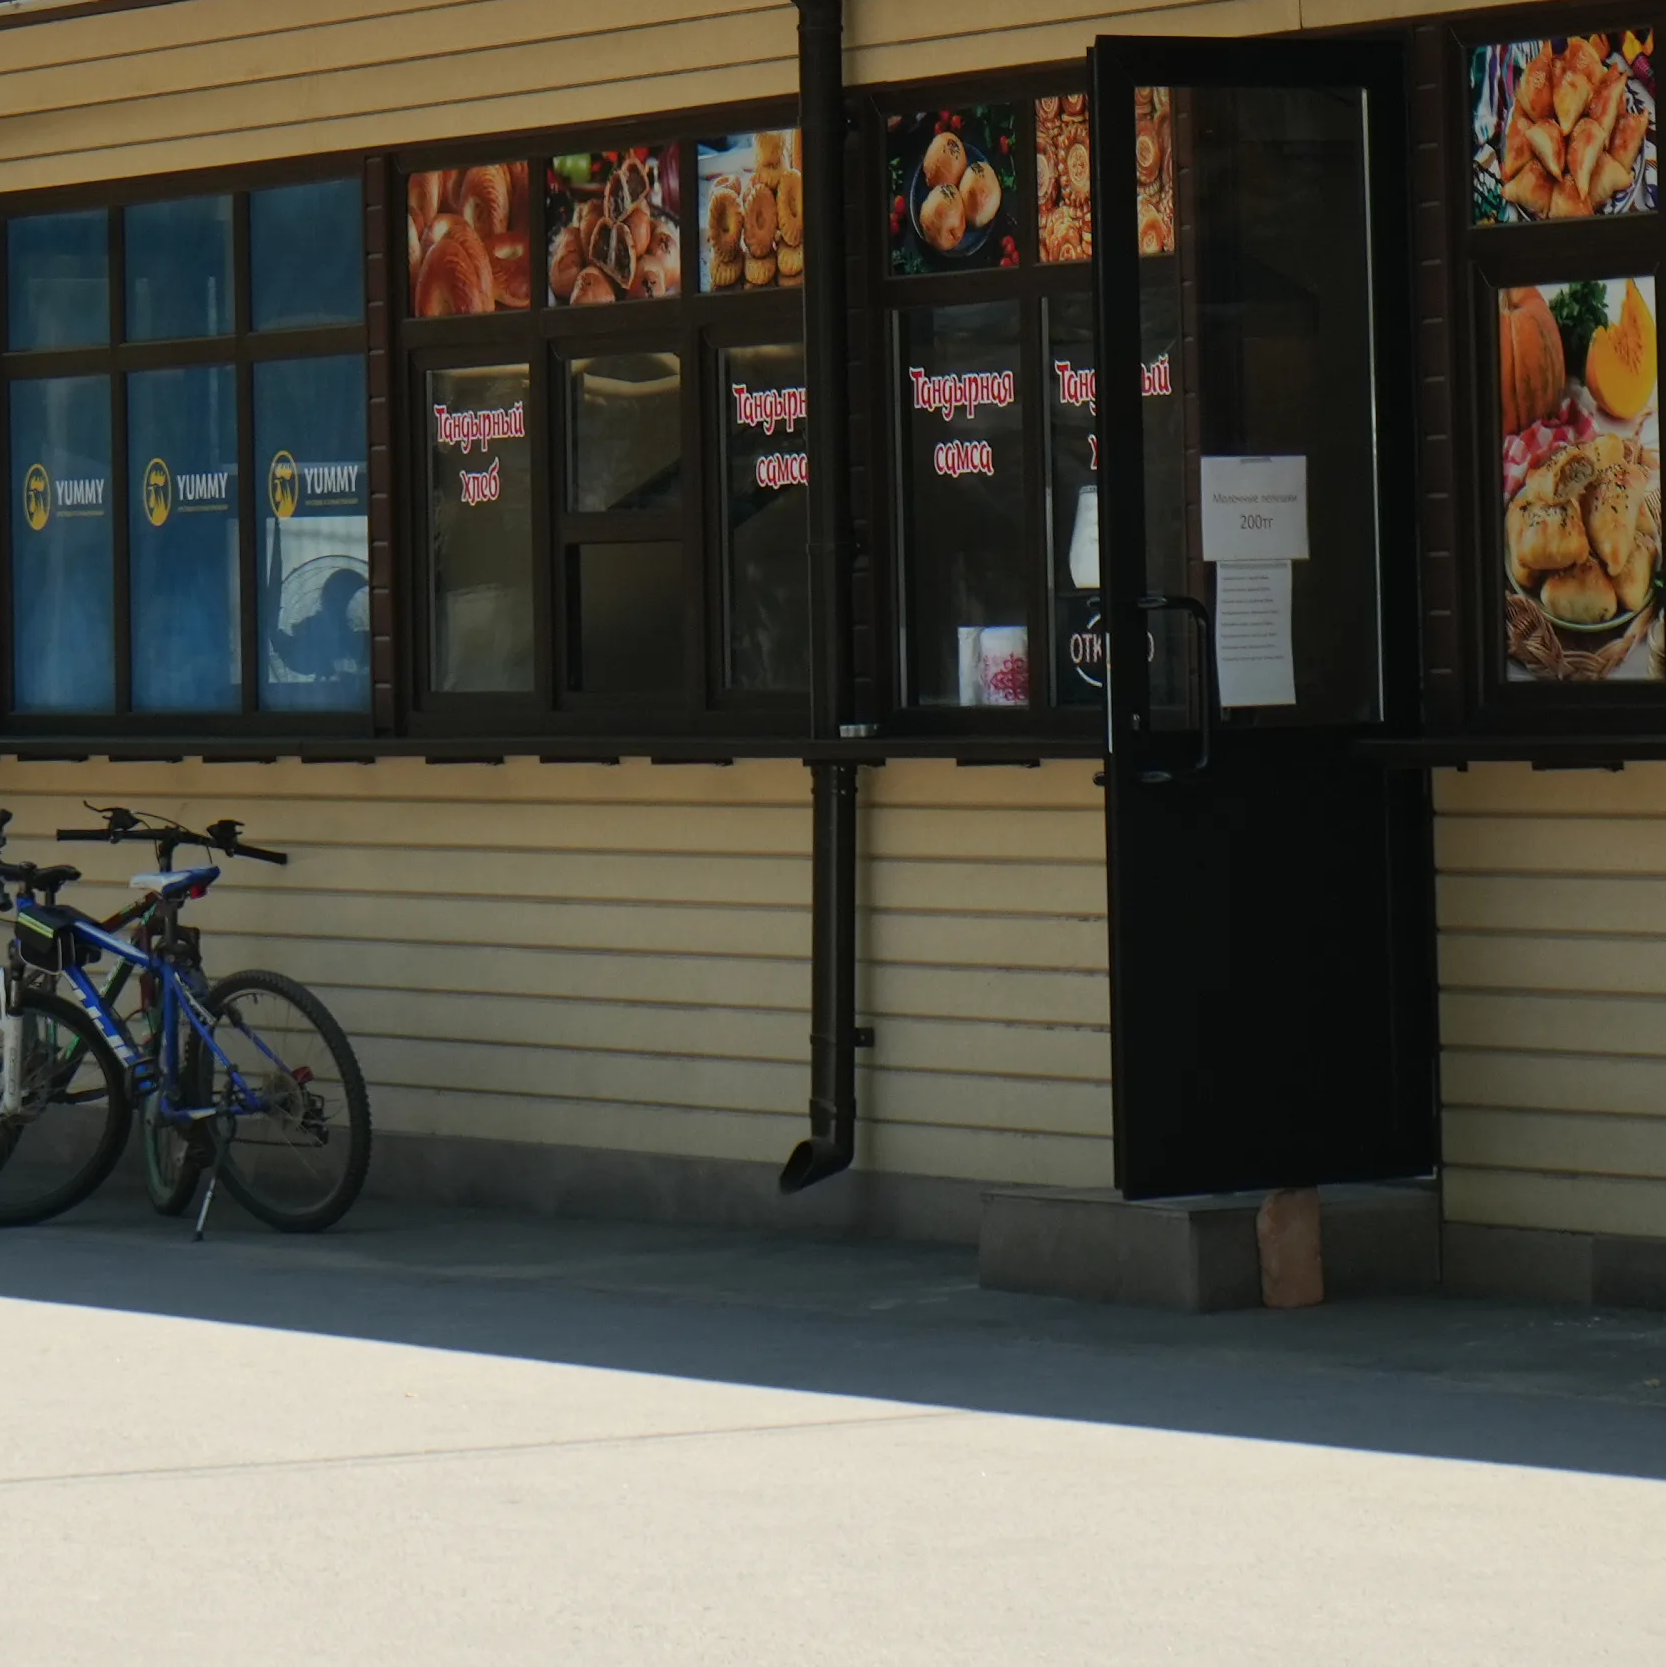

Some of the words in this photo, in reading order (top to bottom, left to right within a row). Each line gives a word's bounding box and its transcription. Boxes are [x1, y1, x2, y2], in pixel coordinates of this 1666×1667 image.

[732, 383, 807, 435] Тандырн
[909, 366, 1014, 421] Тандырная
[434, 400, 525, 454] Тандырный
[756, 452, 809, 489] самса
[934, 439, 995, 478] самса
[55, 478, 105, 506] YUMMY
[176, 472, 229, 501] YUMMY
[304, 464, 359, 495] YUMMY
[459, 456, 500, 506] хлеб
[1240, 513, 1274, 530] 200тг
